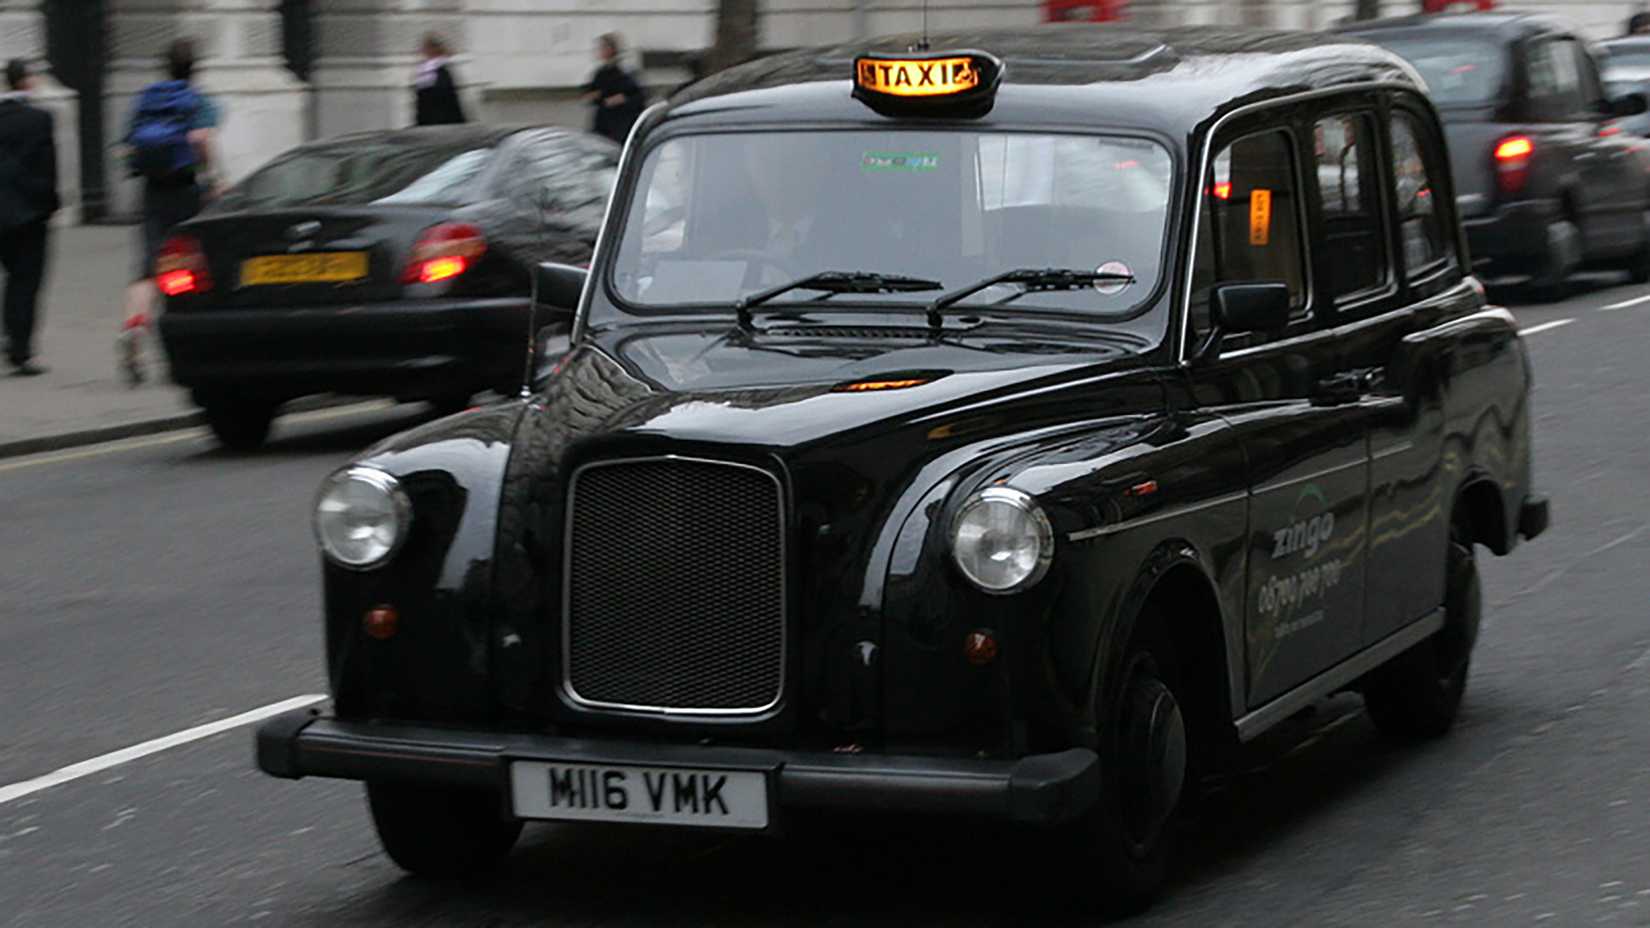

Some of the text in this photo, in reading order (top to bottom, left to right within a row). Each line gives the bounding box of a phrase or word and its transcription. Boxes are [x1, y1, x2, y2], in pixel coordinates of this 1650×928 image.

[879, 63, 948, 87] TAXI
[1271, 512, 1335, 559] zingo
[643, 772, 728, 815] VMK
